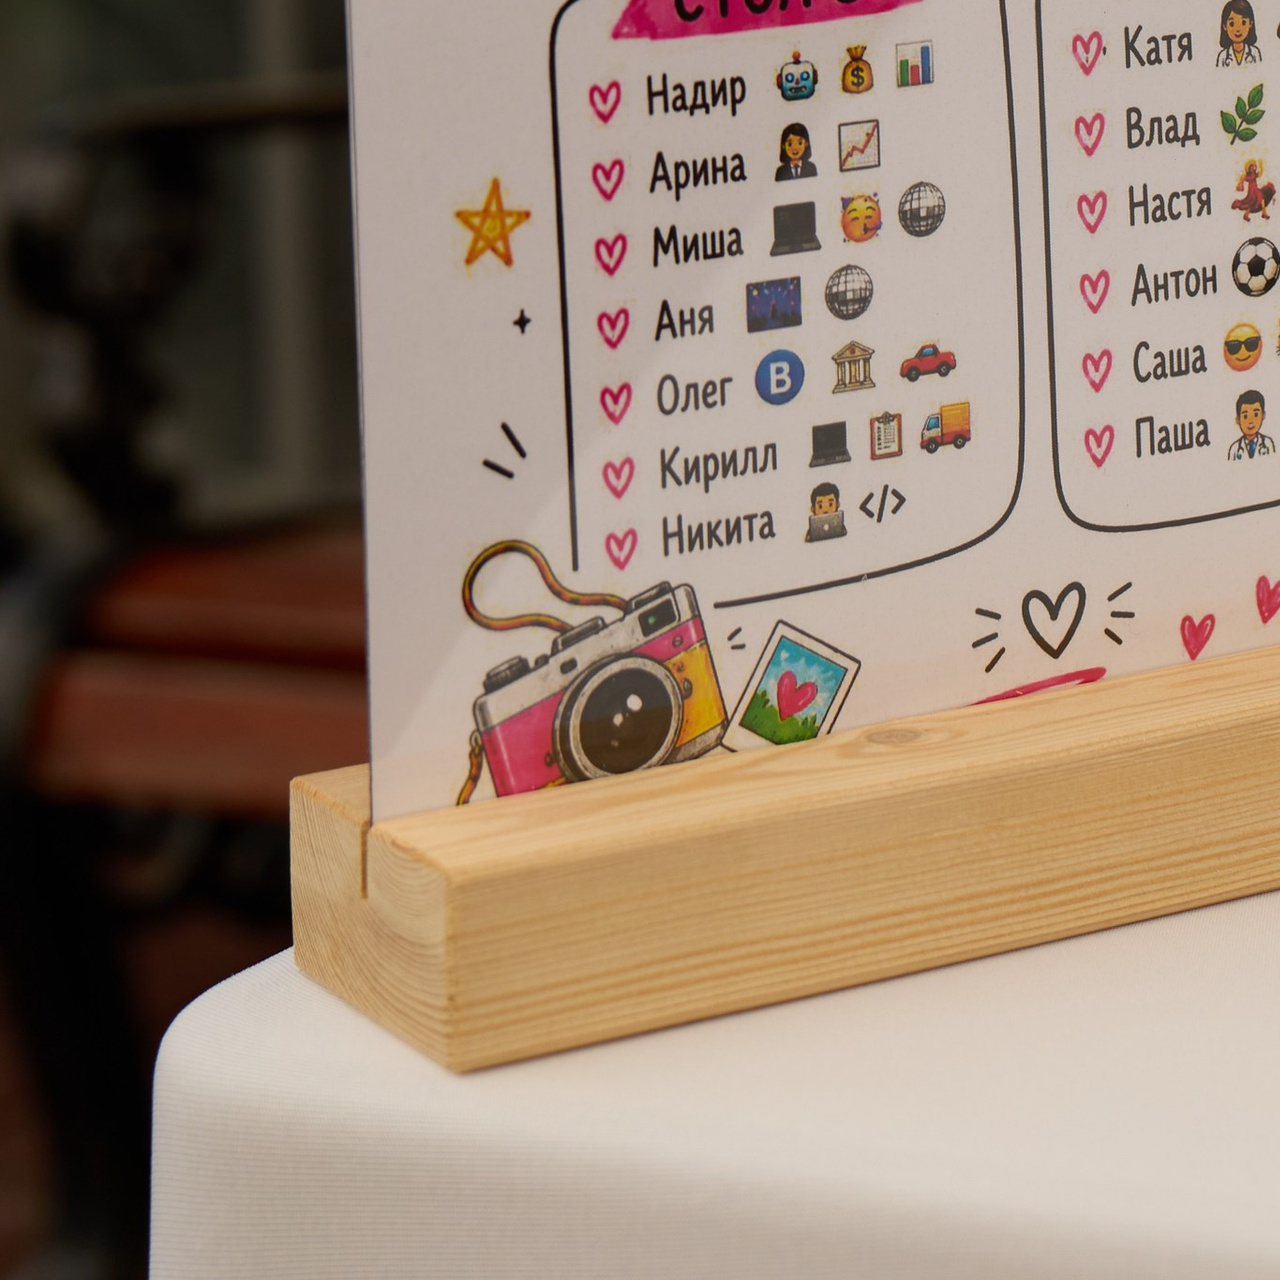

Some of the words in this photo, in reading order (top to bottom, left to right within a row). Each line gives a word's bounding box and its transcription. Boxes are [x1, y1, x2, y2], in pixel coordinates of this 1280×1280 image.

[1124, 24, 1193, 69] Катя
[646, 72, 747, 117] Надир
[1125, 106, 1201, 150] Влад
[649, 151, 748, 203] Арина
[1128, 183, 1212, 227] Настя
[653, 224, 744, 268] Миша
[1131, 263, 1218, 307] Антон
[654, 299, 714, 342] Аня
[1133, 340, 1208, 384] Саша
[656, 373, 734, 416] Олег
[1135, 415, 1211, 459] Паша
[660, 442, 778, 494] Кирилл
[662, 510, 777, 558] Никита
